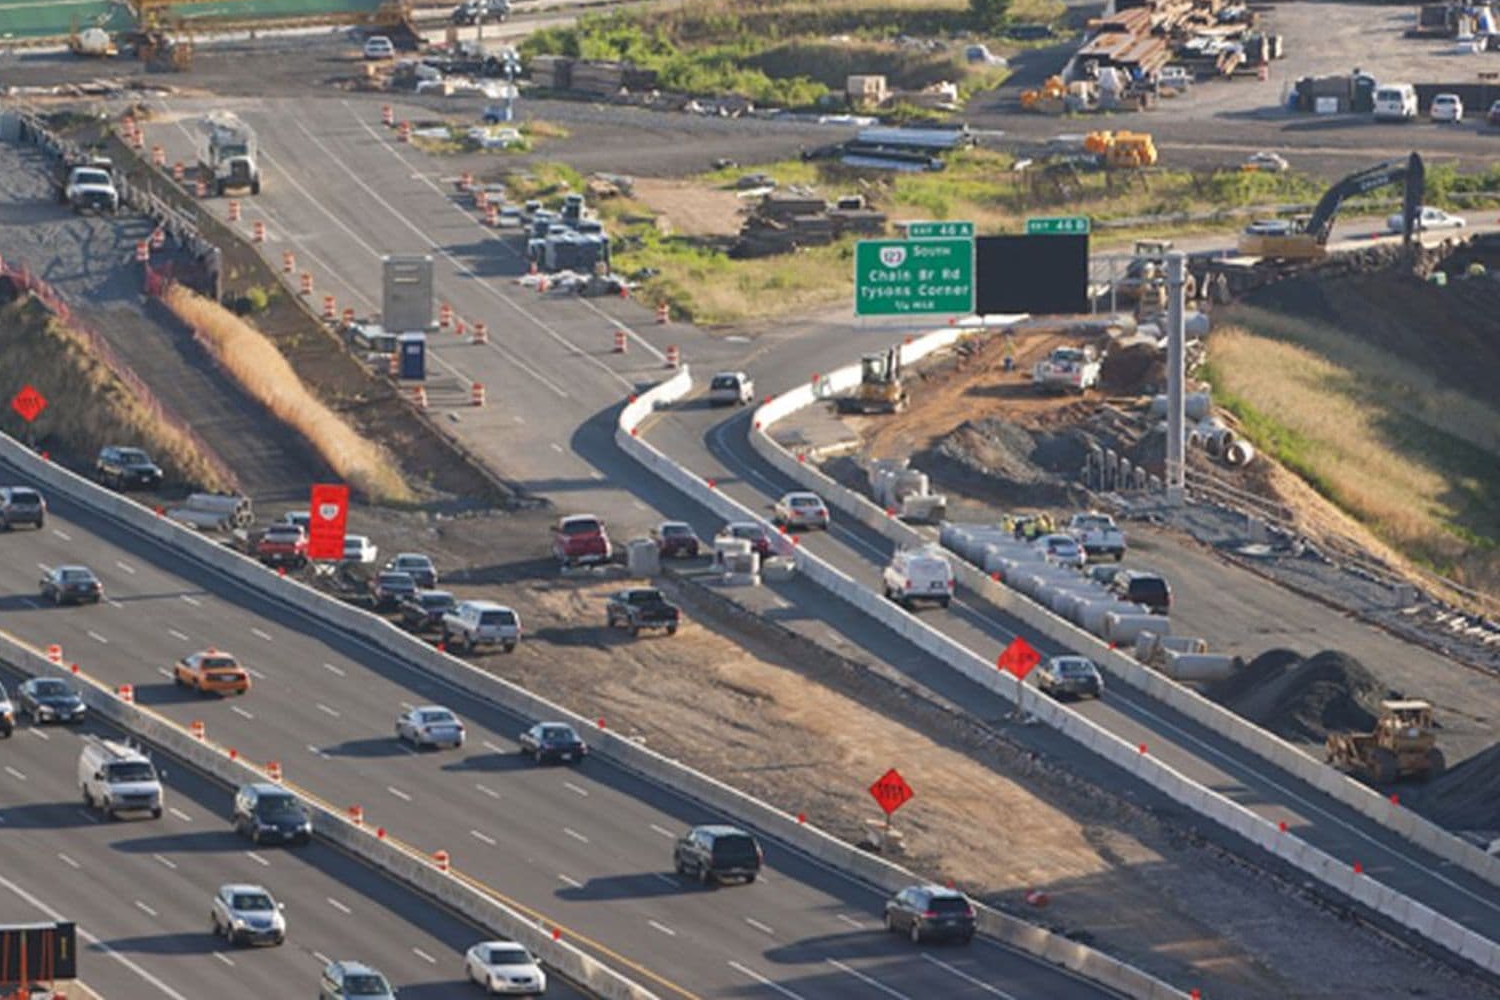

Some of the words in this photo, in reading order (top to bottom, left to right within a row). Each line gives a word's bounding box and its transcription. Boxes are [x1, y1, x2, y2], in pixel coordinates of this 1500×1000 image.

[869, 269, 911, 282] Chain
[918, 269, 935, 280] Br
[941, 268, 960, 280] Rd
[861, 286, 911, 300] Tysons
[918, 284, 969, 296] Corner
